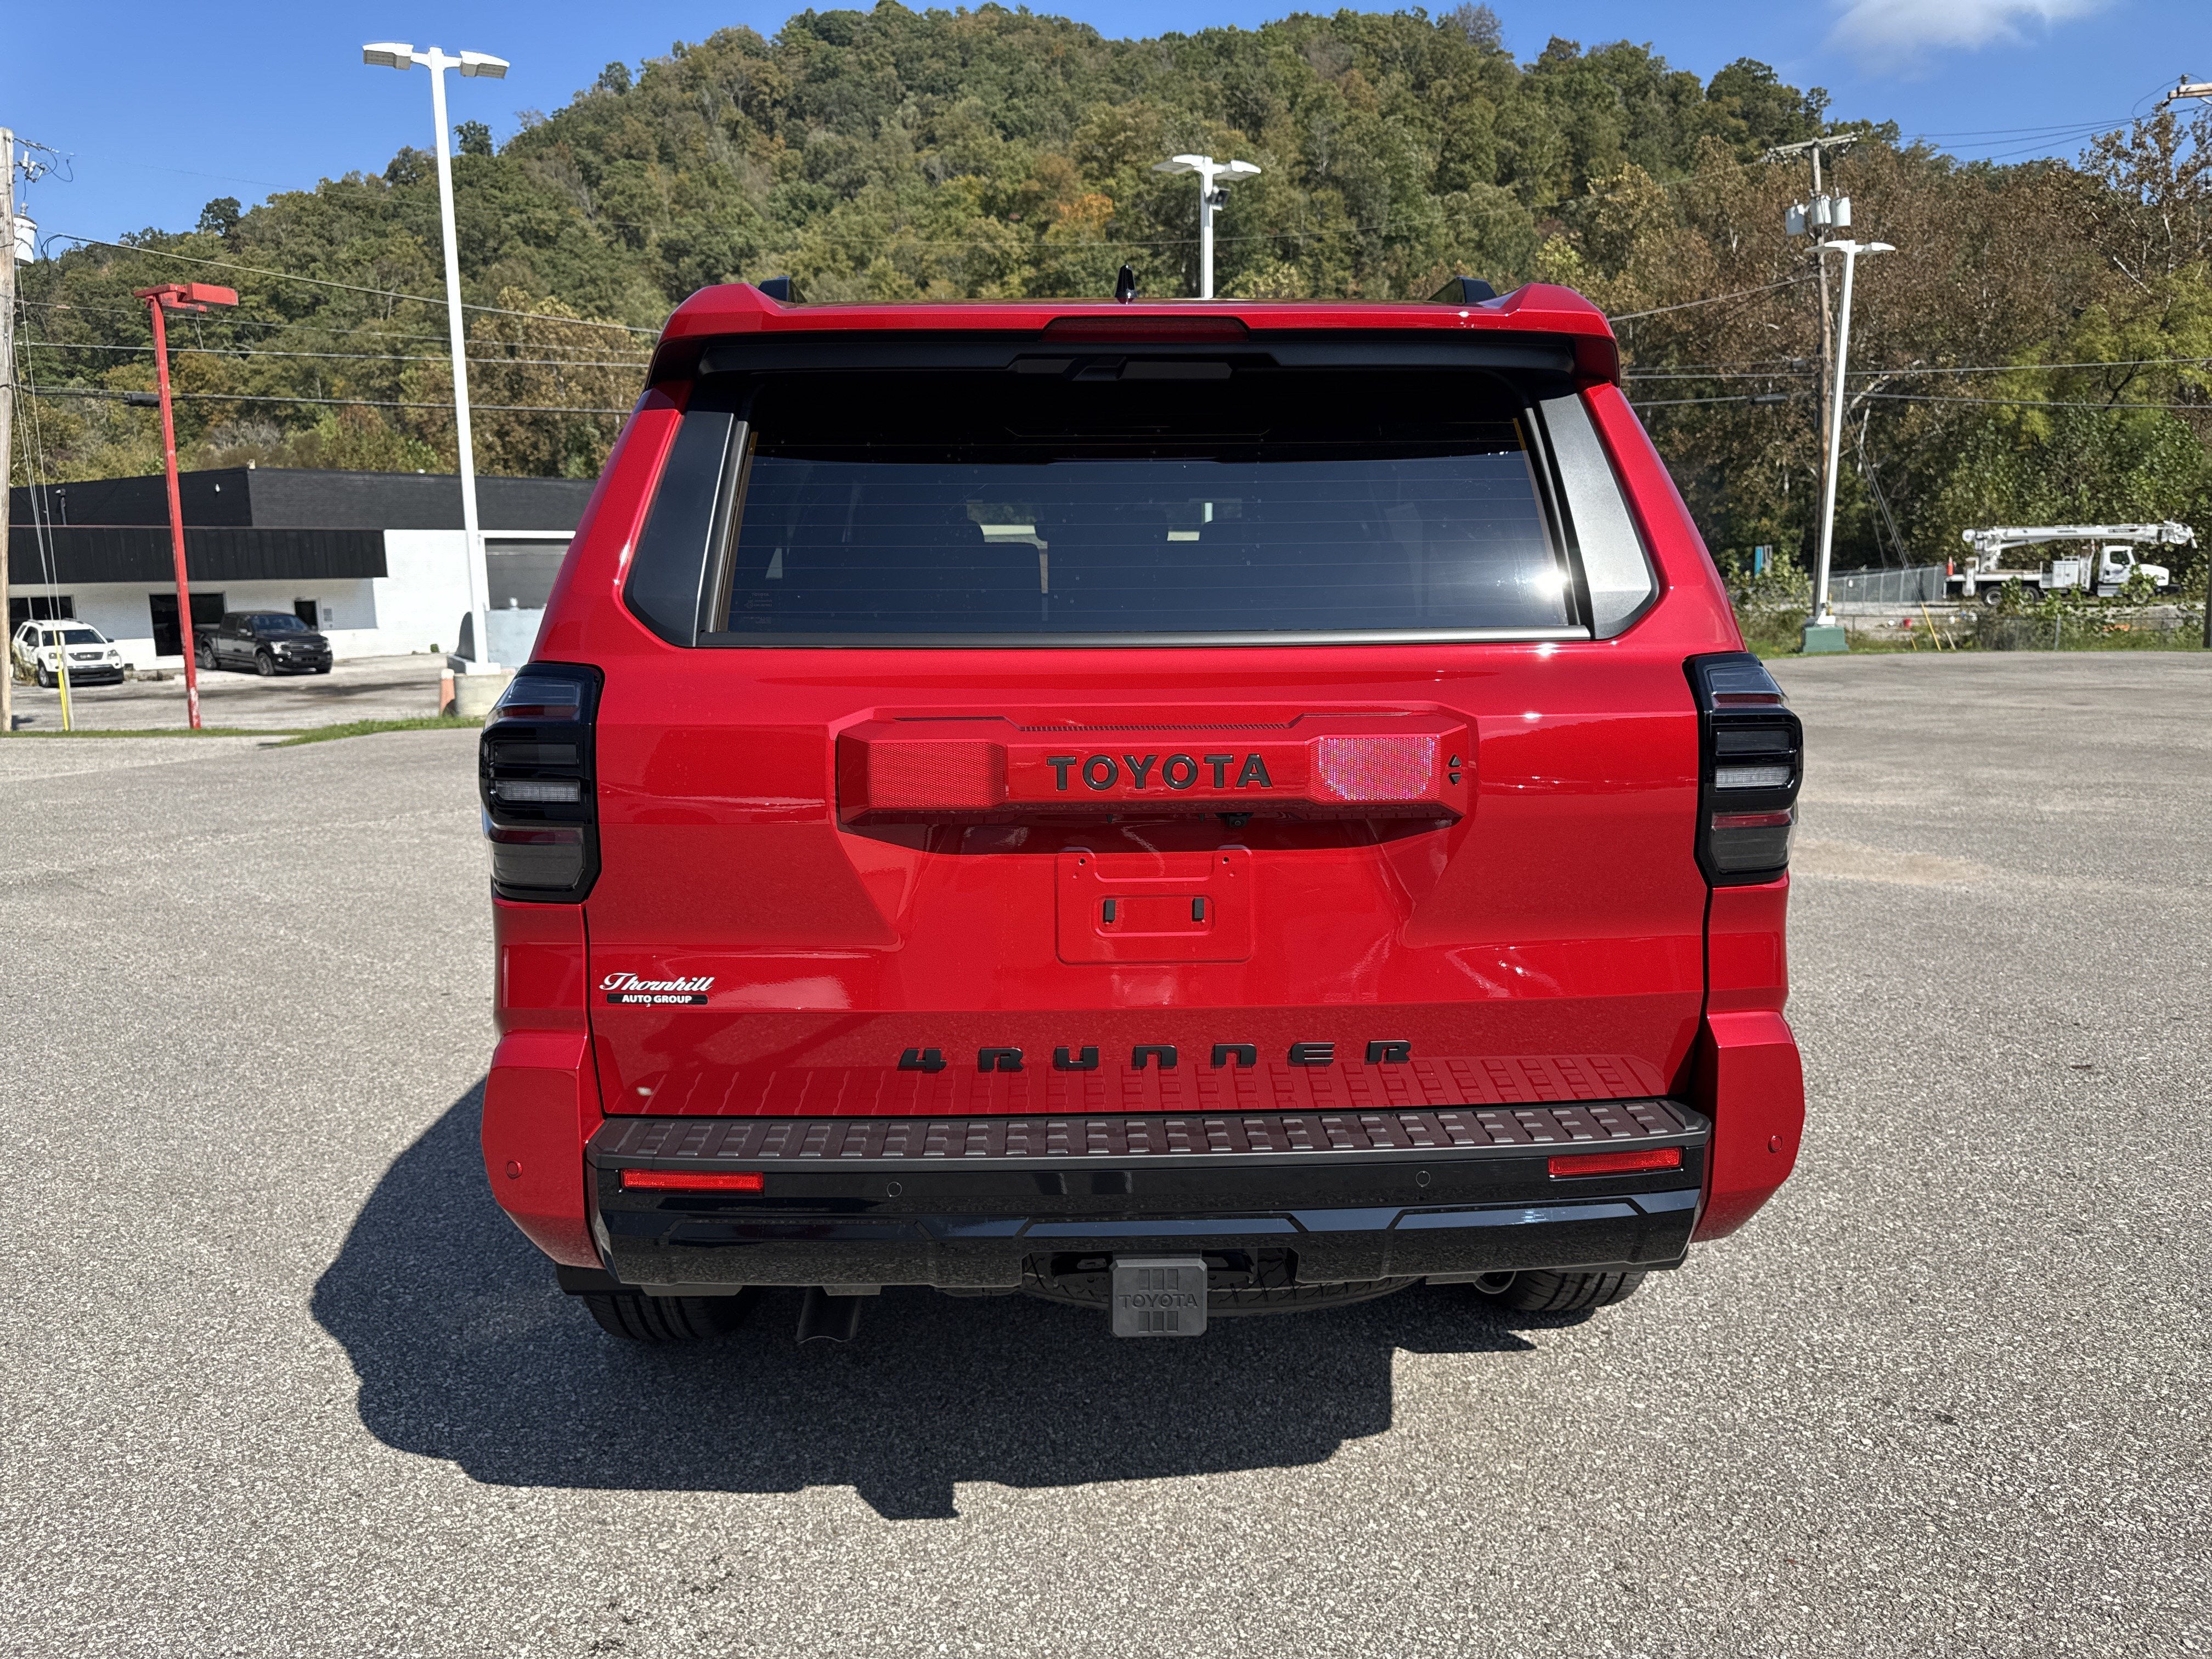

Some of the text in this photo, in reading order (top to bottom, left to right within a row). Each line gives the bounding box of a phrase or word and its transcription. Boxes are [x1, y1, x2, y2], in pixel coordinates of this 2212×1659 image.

[1046, 754, 1273, 791] TOYOTA
[599, 972, 715, 991] Thornhill
[622, 995, 692, 1003] AUTO GROUP
[896, 1040, 1411, 1073] 4RUNNER
[1116, 1293, 1198, 1308] TOYOTA
